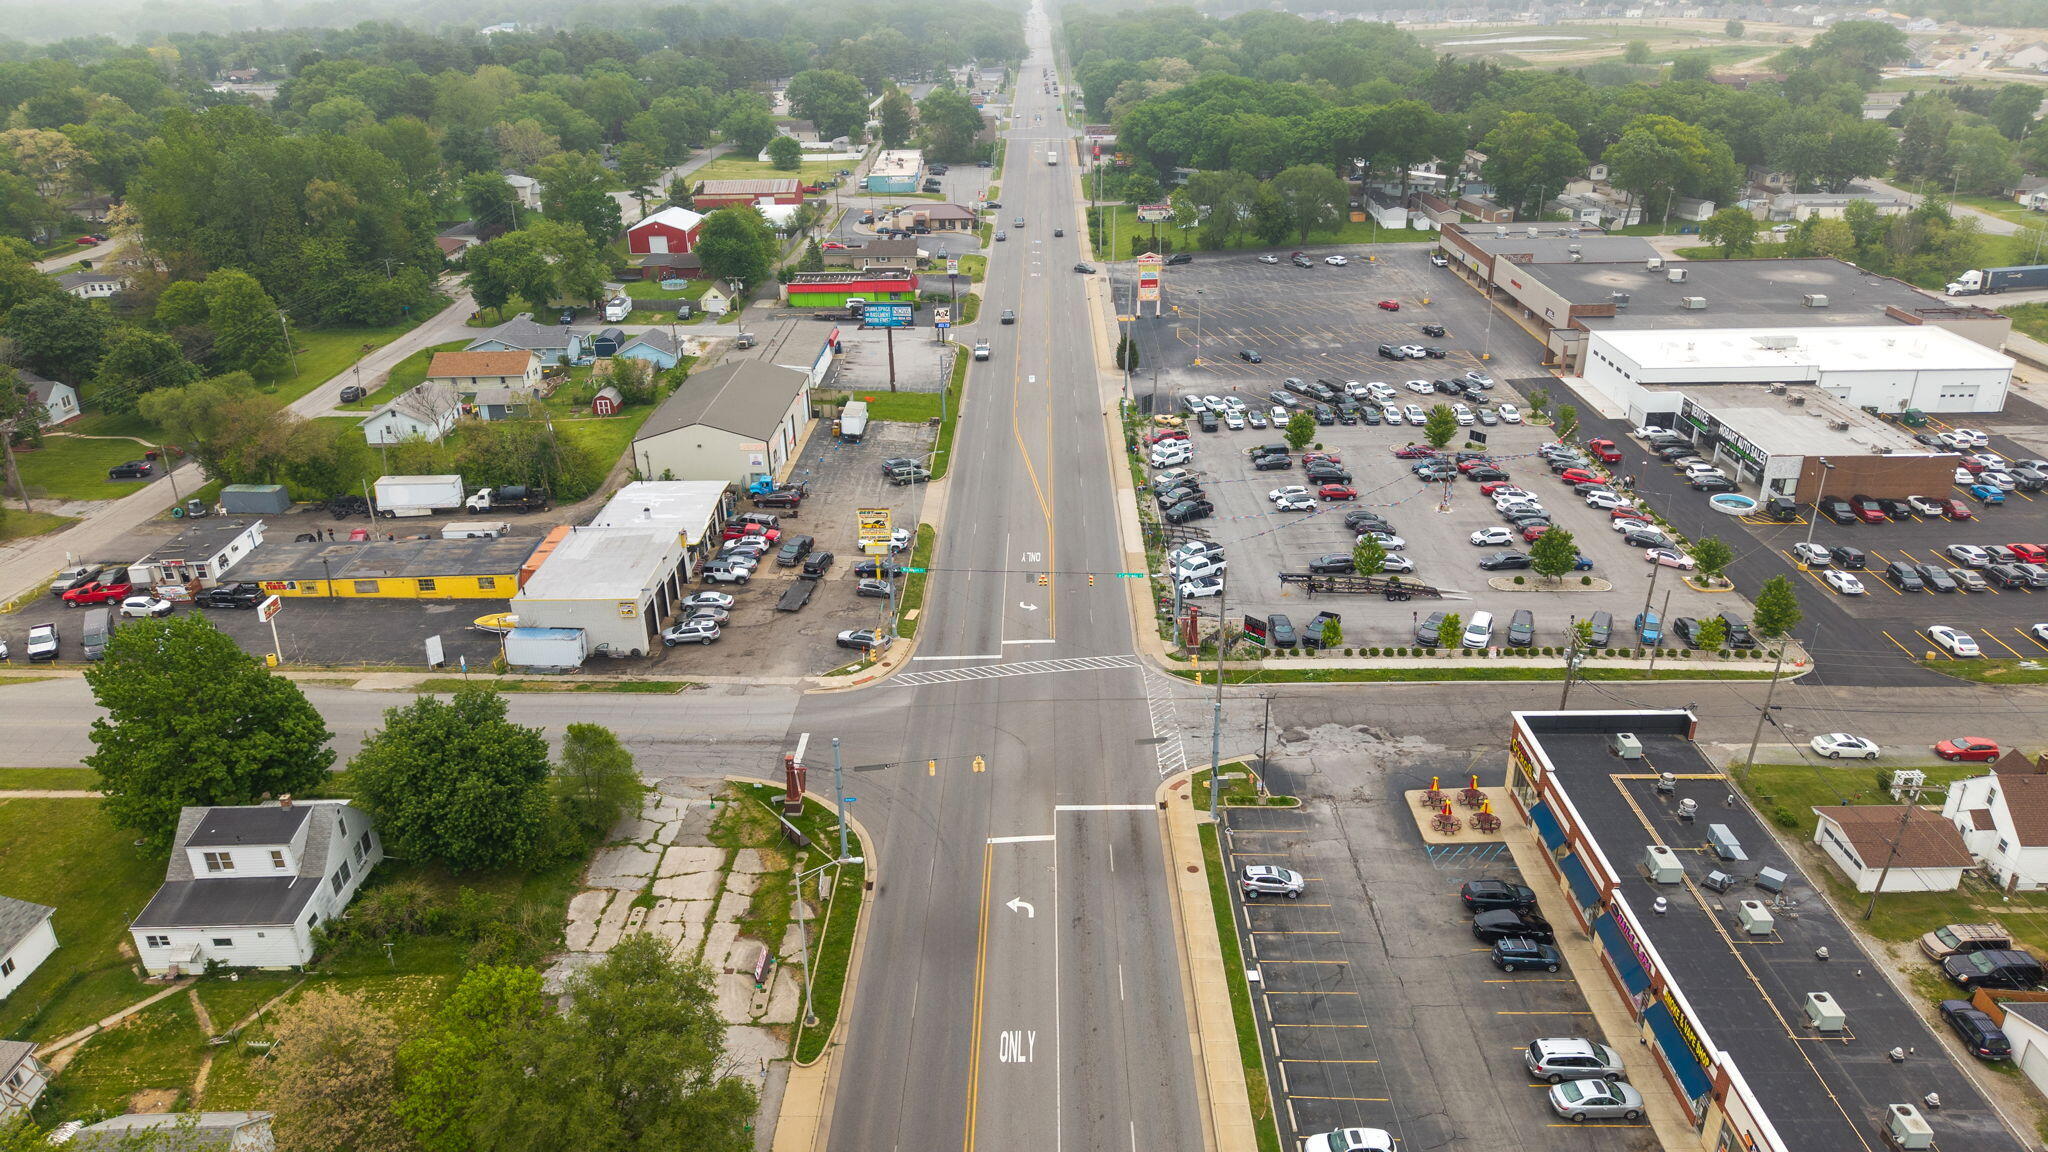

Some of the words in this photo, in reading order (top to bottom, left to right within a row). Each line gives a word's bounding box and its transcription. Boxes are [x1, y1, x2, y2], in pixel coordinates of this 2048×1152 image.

[1691, 405, 1709, 425] SERVICE
[1719, 424, 1739, 446] HOBART
[1736, 436, 1751, 454] AUTO
[1750, 443, 1768, 466] SALES
[1020, 552, 1041, 563] ONLY
[1638, 951, 1651, 972] SPA
[1664, 990, 1680, 1021] SMOKE
[1683, 1020, 1697, 1049] VAPE
[1696, 1041, 1711, 1068] SHOP
[1000, 1030, 1036, 1063] ONLY
